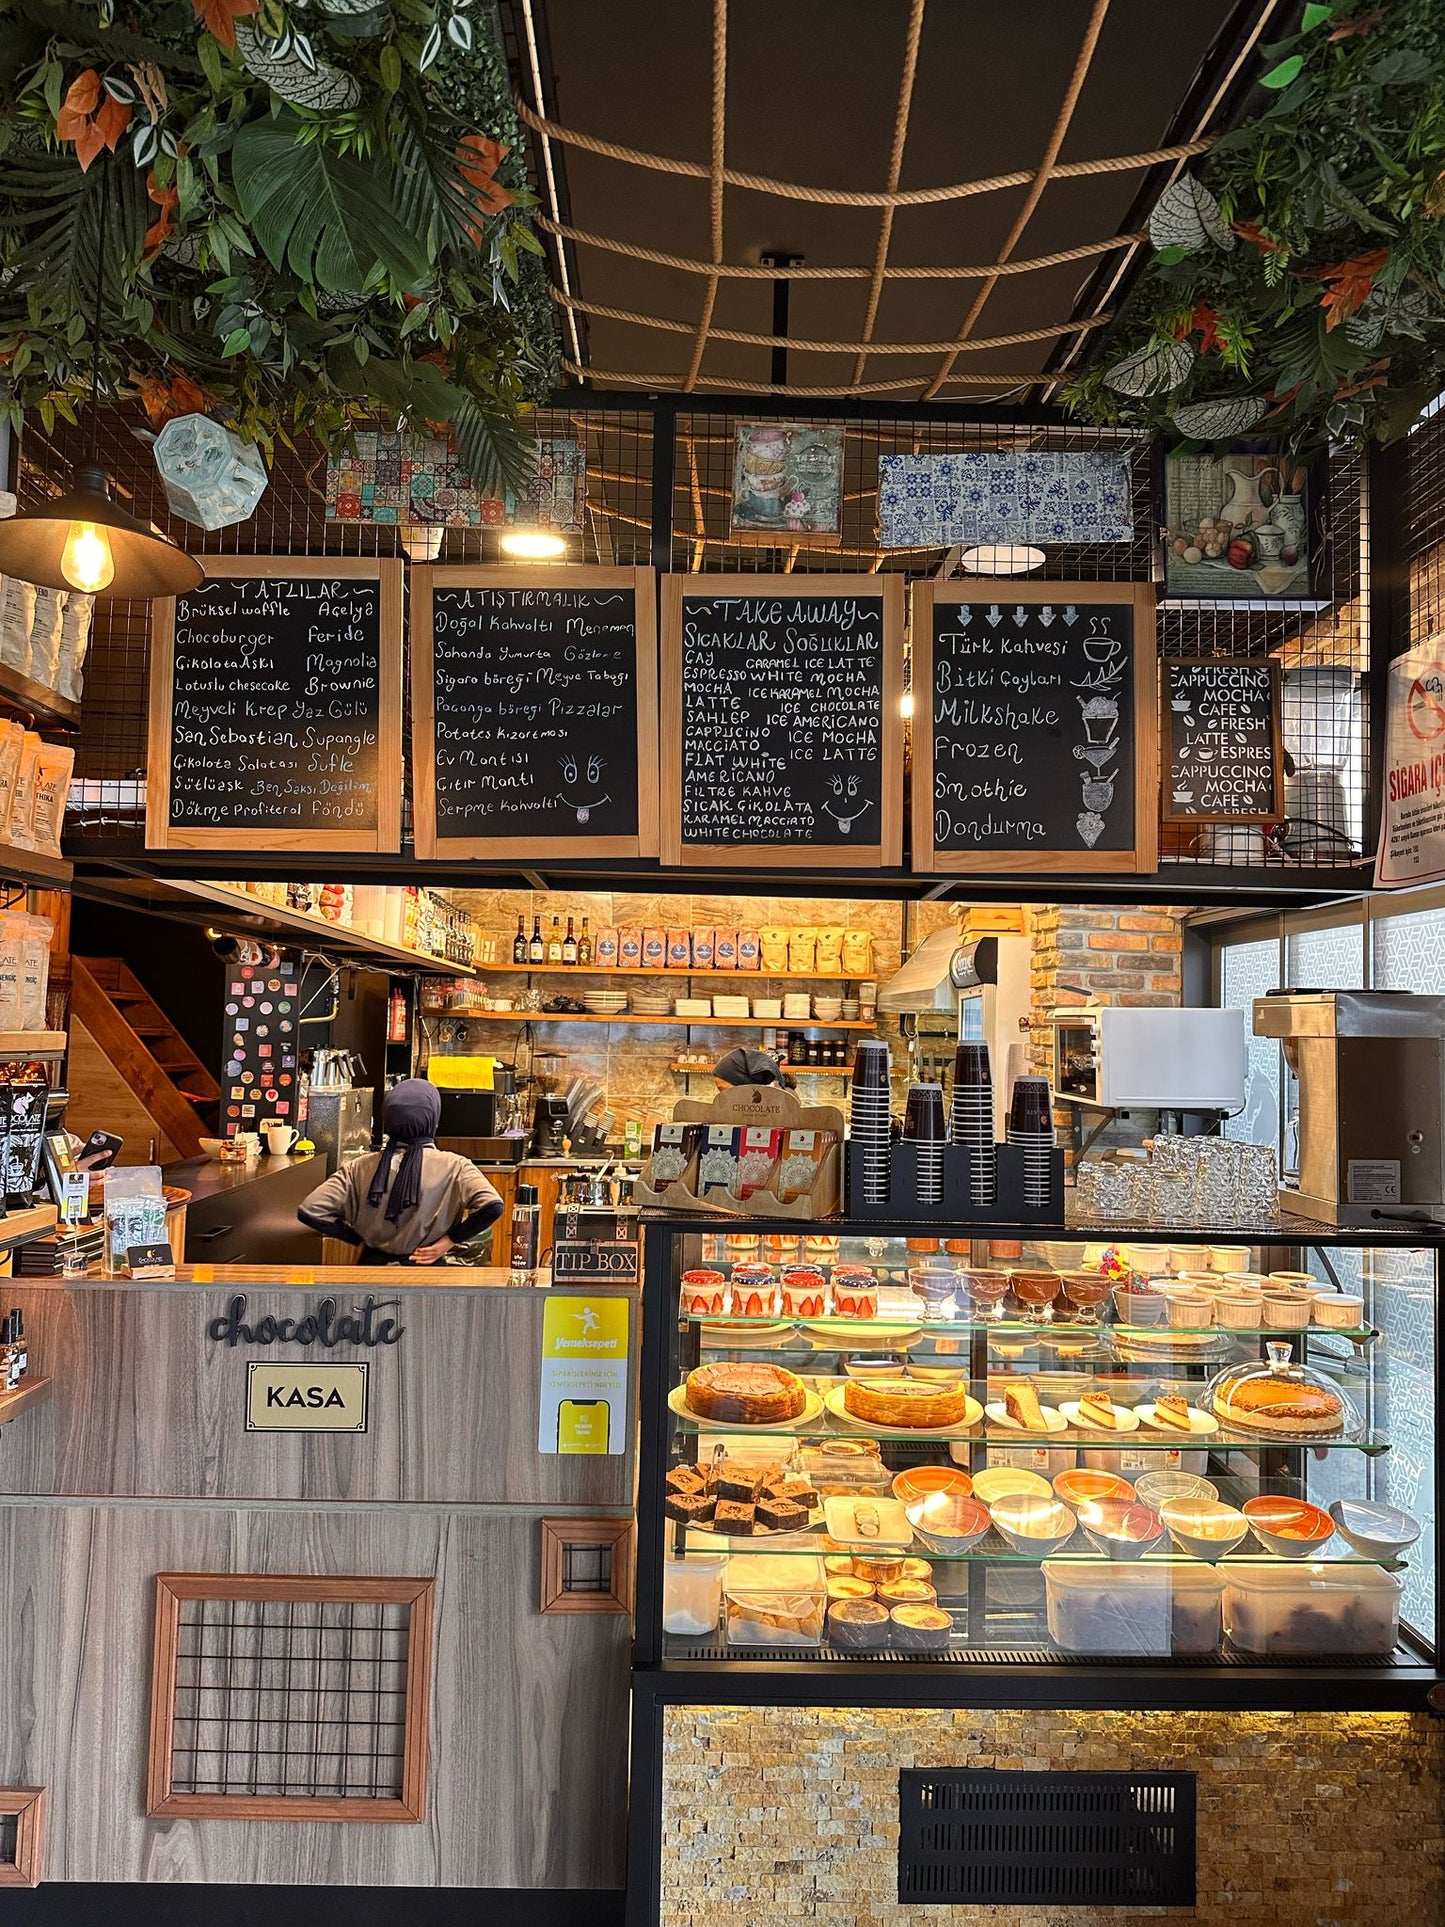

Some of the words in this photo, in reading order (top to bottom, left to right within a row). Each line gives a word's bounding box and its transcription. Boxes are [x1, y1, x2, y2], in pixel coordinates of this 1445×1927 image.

[230, 580, 349, 599] TATLILAR
[457, 589, 591, 610] ATIŞTIRMALIK
[177, 600, 237, 622] Brüksel
[241, 600, 290, 616] waffle
[318, 601, 373, 623] Açelya
[713, 599, 783, 624] TAKE
[787, 600, 856, 631] AWAY
[435, 611, 483, 636] Doğal
[176, 628, 274, 656] Chocoburger
[308, 624, 364, 643] Feride
[938, 631, 994, 655] Türk
[1001, 637, 1069, 656] Kahvesi
[499, 646, 551, 661] Yumurta
[306, 652, 377, 675] Magnolia
[745, 656, 800, 670] CARAMEL
[805, 658, 825, 669] ICE
[828, 656, 876, 670] LATTE
[536, 667, 582, 688] Meyve
[684, 666, 747, 681] ESPRESSO
[750, 669, 803, 682] WHITE
[810, 671, 867, 686] MOCHA
[936, 660, 994, 693] Bitki
[1000, 670, 1061, 693] Çayları
[1170, 674, 1270, 687] CAPPUCCINO
[175, 677, 225, 691] Lotuslu
[229, 679, 291, 691] chesecake
[304, 676, 375, 695] Brownie
[684, 682, 733, 695] MOCHA
[748, 687, 768, 698] ICE
[826, 685, 880, 700] MOCHA
[685, 694, 742, 710] LATTE
[1203, 689, 1264, 702] MOCHA
[174, 700, 237, 723] Meyveli
[245, 700, 288, 720] Krep
[292, 700, 325, 719] Yaz
[328, 700, 368, 719] Gülü
[547, 697, 623, 717] Pizzalar
[780, 702, 801, 714] ICE
[810, 700, 880, 713] CHOCOLATE
[1198, 703, 1237, 716] CAFE
[686, 710, 750, 724] SAHLEP
[766, 713, 789, 727] ICE
[1221, 717, 1266, 730] FRESH
[174, 725, 207, 746] San
[209, 725, 298, 748] Sebastian
[302, 726, 376, 755] Supangle
[788, 730, 814, 743] ICE
[821, 729, 877, 744] MOCHA
[1186, 732, 1229, 745] LATTE
[436, 748, 455, 766] Ev
[790, 748, 814, 760] ICE
[822, 747, 878, 761] LATTE
[935, 736, 1023, 764] Frozen
[307, 752, 354, 772] Sufle
[685, 752, 725, 767] FLAT
[1171, 765, 1271, 778] CAPPUCCINO
[250, 780, 283, 797] Ben
[436, 777, 476, 792] Çıtır
[481, 772, 534, 790] Mantı
[935, 772, 1027, 801] Smothie
[1205, 780, 1267, 793] MOCHA
[1389, 760, 1427, 802] SİGARA
[743, 785, 792, 798] KAHVE
[1201, 794, 1239, 807] CAFE
[172, 798, 229, 822] Dökme
[234, 801, 301, 817] Profiterol
[312, 798, 364, 819] Föndü
[438, 797, 494, 818] Serpme
[683, 799, 733, 813] SICAK
[683, 814, 745, 825] KARAMEL
[935, 809, 1047, 842] Dondurma
[684, 827, 730, 838] WHITE
[732, 828, 813, 839] CHOCOLATE
[732, 1103, 781, 1114] CHOCOLATE
[556, 1252, 591, 1272] TIP
[597, 1252, 637, 1272] BOX
[210, 1293, 407, 1348] chocolate
[555, 1337, 618, 1350] Yemeksepeti
[266, 1386, 346, 1409] KASA
